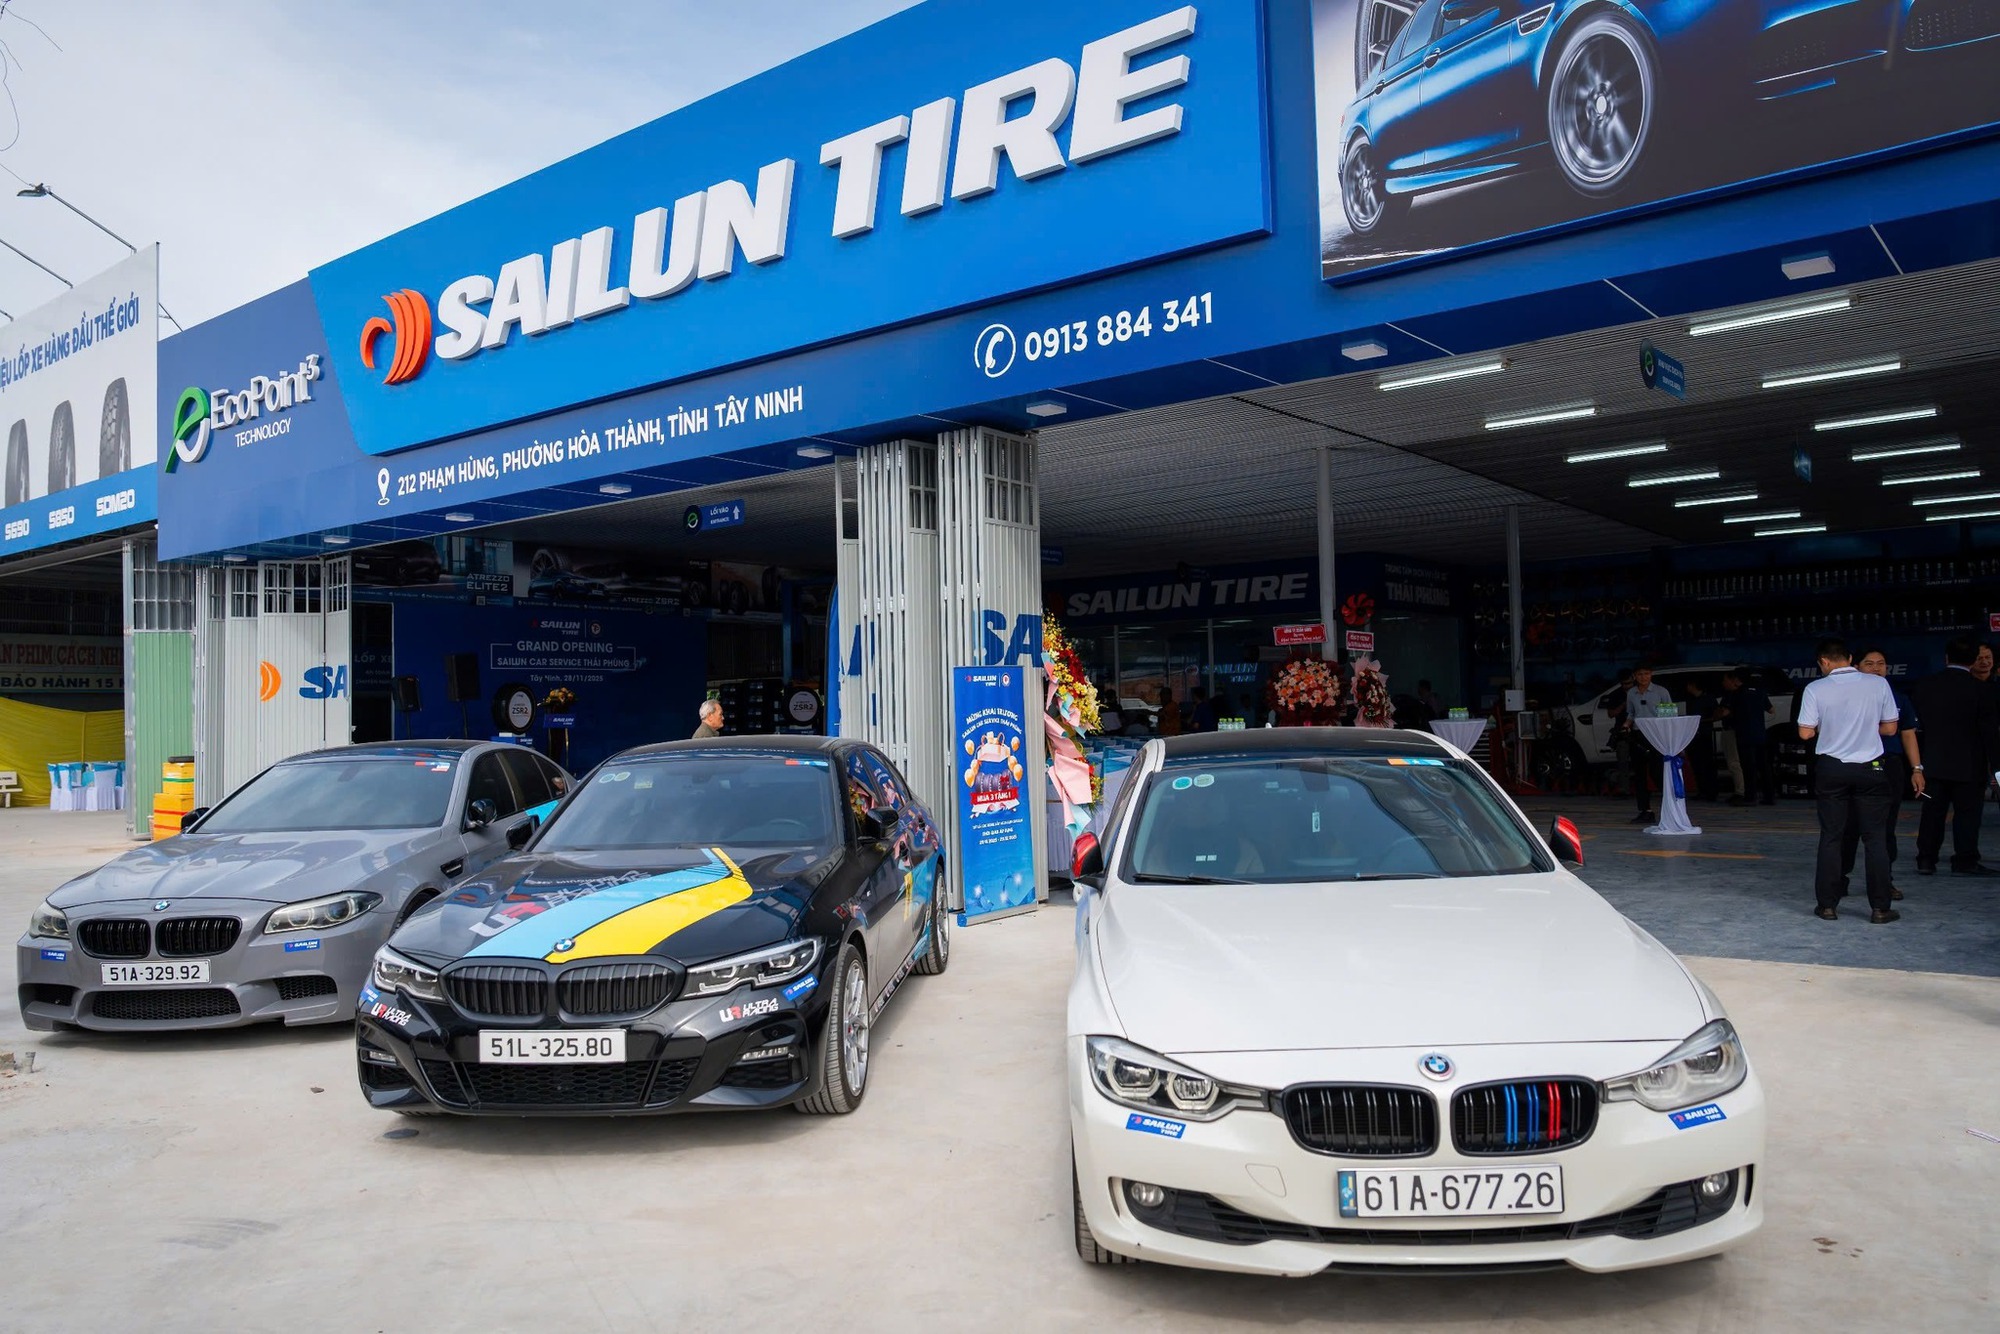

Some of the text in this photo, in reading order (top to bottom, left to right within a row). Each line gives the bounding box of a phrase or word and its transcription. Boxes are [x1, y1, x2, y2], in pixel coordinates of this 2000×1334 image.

[435, 4, 1198, 360] SAILUN TIRE
[1024, 292, 1212, 361] 0913 884 341
[13, 343, 30, 380] LỐP
[31, 345, 43, 373] XE
[44, 332, 70, 367] HÀNG
[72, 311, 94, 354] ĐẦU
[94, 297, 116, 342] THẾ
[116, 291, 139, 332] GIỚI
[235, 417, 292, 448] TECHNOLOGY
[397, 386, 803, 497] 212 PHẠM HÙNG, PHƯỜNG HÒA THÀNH, TỈNH TÂY NINH
[466, 573, 510, 582] ATREZZO
[466, 582, 508, 591] ELITE2
[1386, 580, 1413, 602] THÁI
[1067, 572, 1309, 617] SAILUN TIRE
[540, 620, 580, 630] SAILUN
[16, 644, 52, 664] PHIM
[57, 640, 96, 666] CÁCH
[517, 640, 613, 653] GRAND OPENING
[354, 652, 376, 663] LỐP
[497, 656, 630, 668] SAILUN CAR SERVICE THÁI PHÙNG
[1202, 662, 1258, 674] SAILUN
[1, 674, 36, 687] BẢO
[42, 676, 90, 688] HÀNH
[96, 678, 114, 688] 15
[530, 674, 542, 682] Tây
[512, 706, 528, 714] ZSR2
[977, 794, 990, 802] MUA
[110, 965, 200, 981] 51A-329.92
[792, 977, 813, 992] SAILUN
[371, 1002, 412, 1022] UR ULTRA
[719, 998, 777, 1023] UR ULTRA
[742, 1004, 779, 1017] RACING
[492, 1038, 612, 1057] 51L-325.80
[1684, 1106, 1719, 1120] SAILUN
[1142, 1118, 1182, 1132] SAILUN
[1364, 1172, 1554, 1211] 61A-677.26
